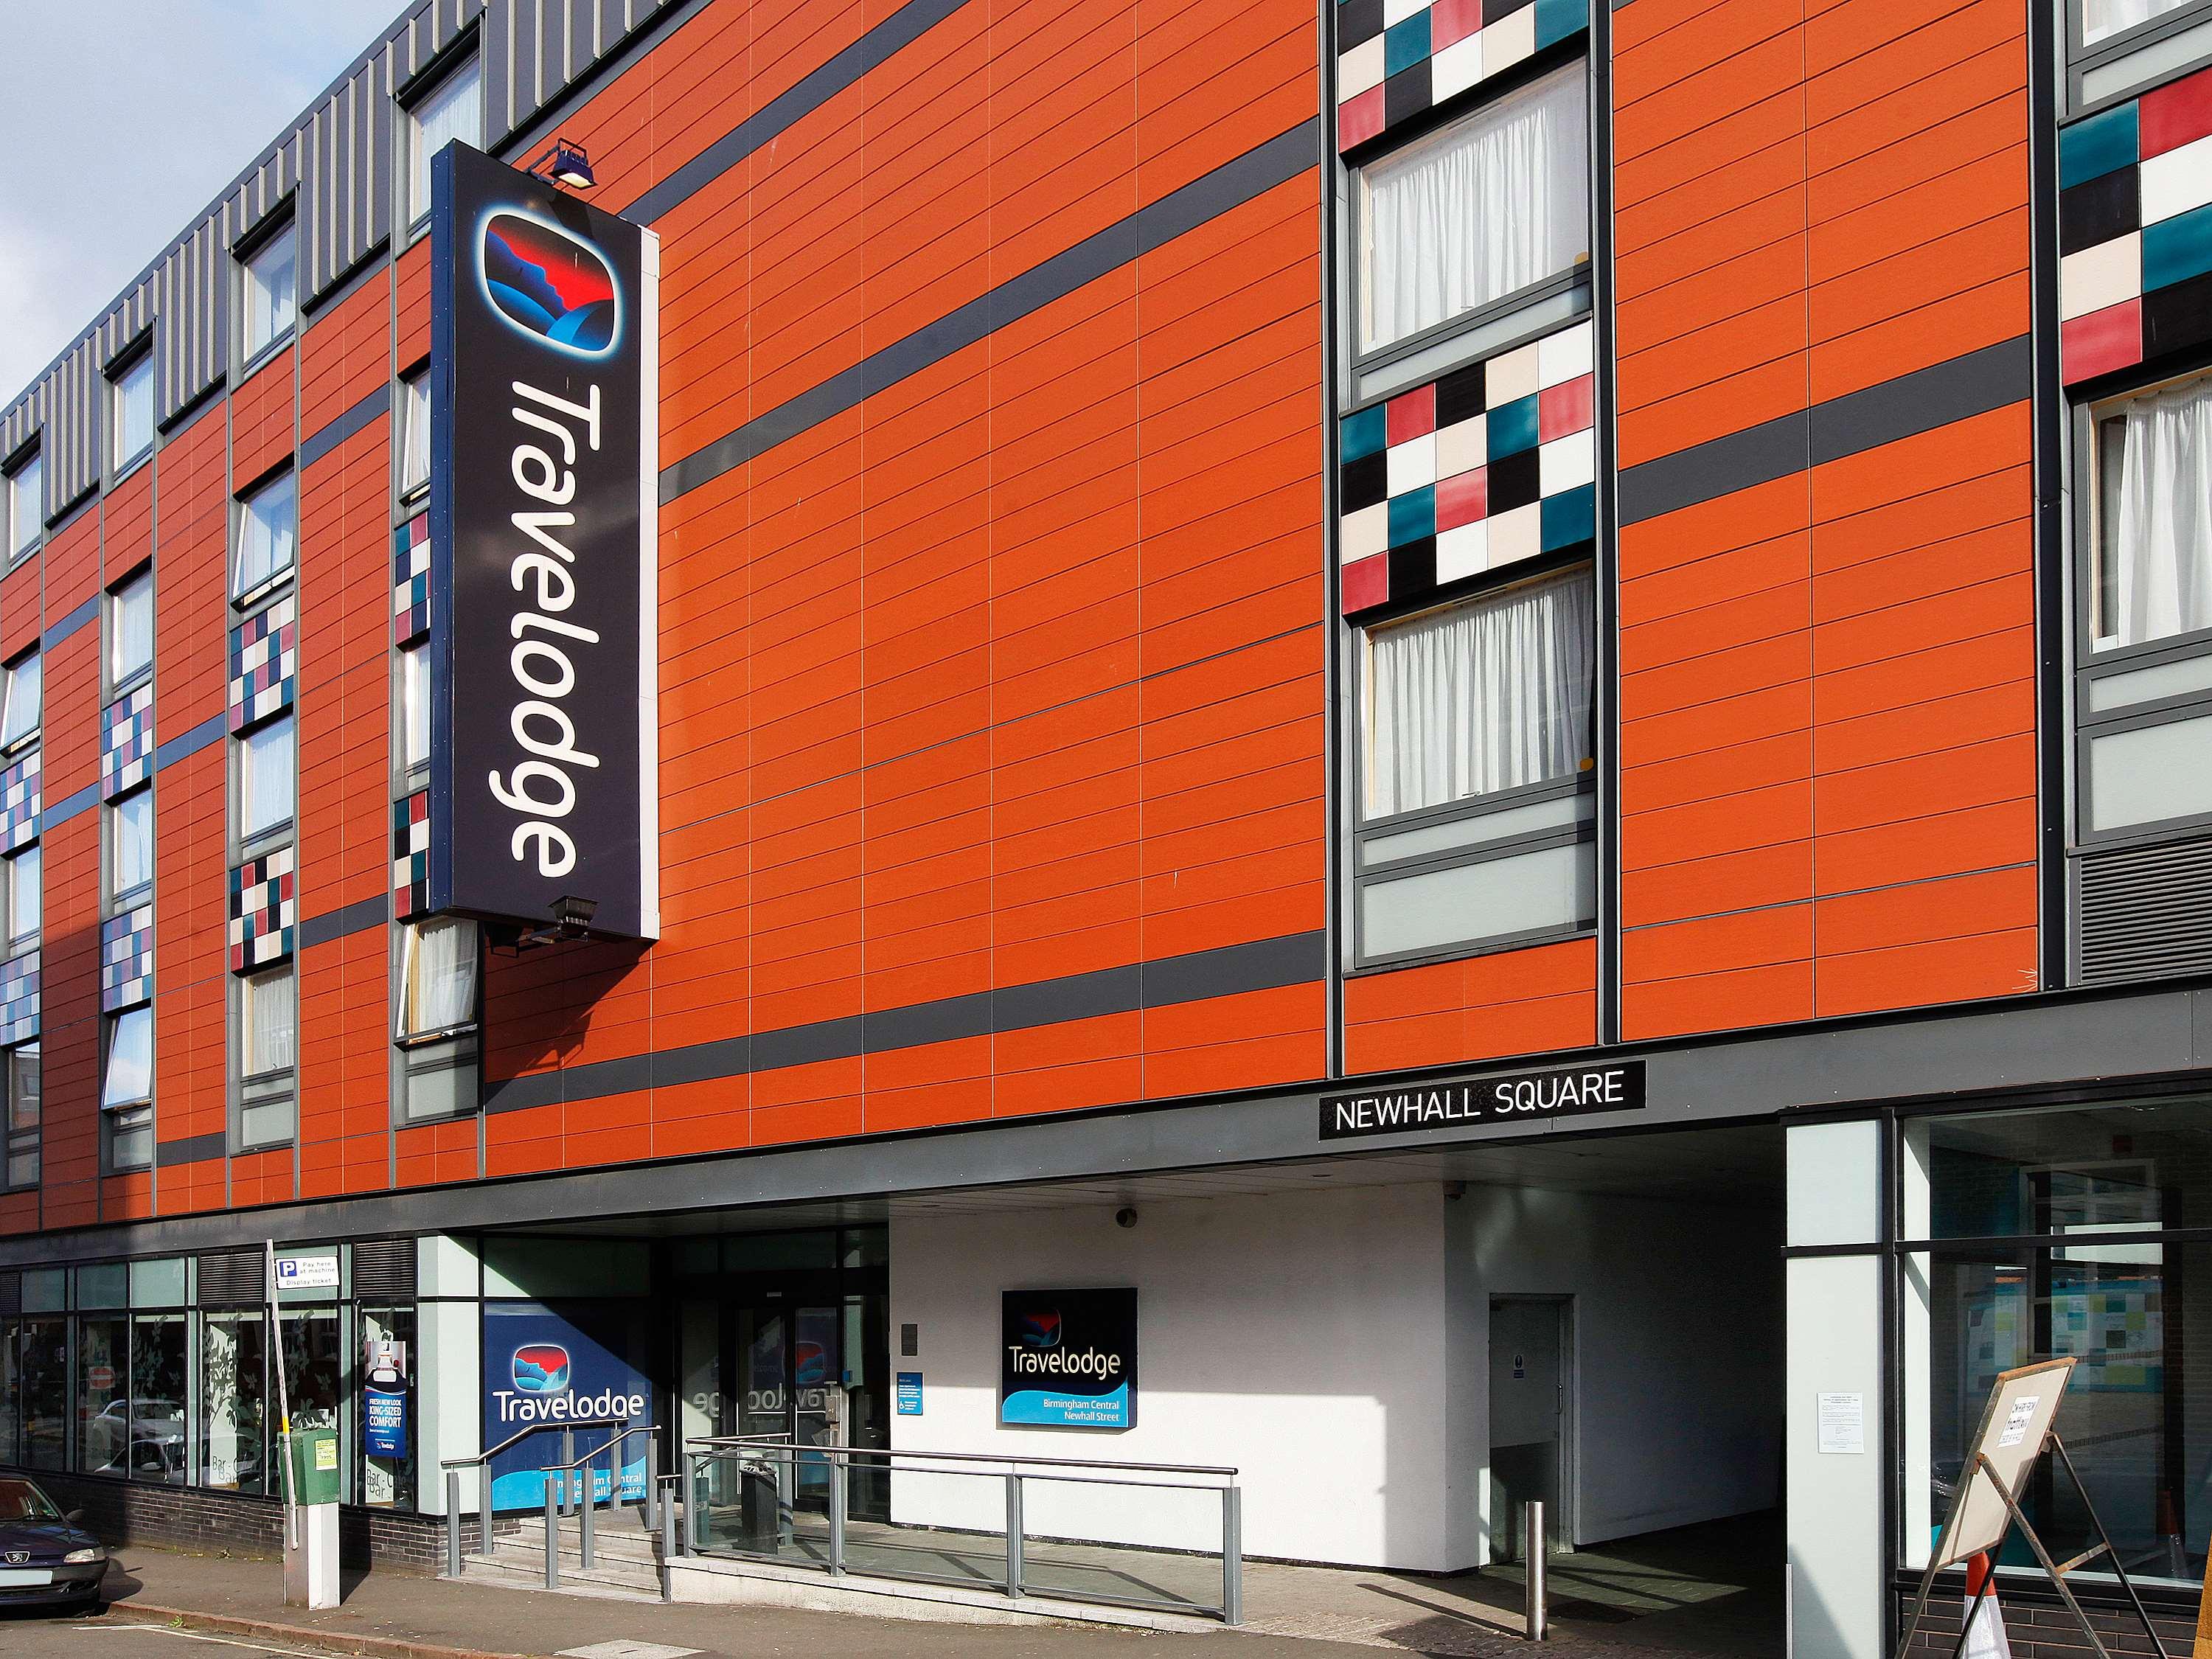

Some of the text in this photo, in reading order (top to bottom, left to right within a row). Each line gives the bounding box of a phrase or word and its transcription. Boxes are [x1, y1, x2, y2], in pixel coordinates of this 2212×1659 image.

[489, 380, 599, 878] Travelodge
[1336, 1070, 1624, 1130] NEWHALL SQUARE
[1009, 1346, 1121, 1380] Travelodge
[369, 1405, 402, 1416] KING-SIZED
[492, 1388, 644, 1422] Travelodge
[1043, 1398, 1119, 1411] Birmingham Central
[369, 1415, 402, 1428] COMFORT
[1064, 1411, 1120, 1422] Newhall Street
